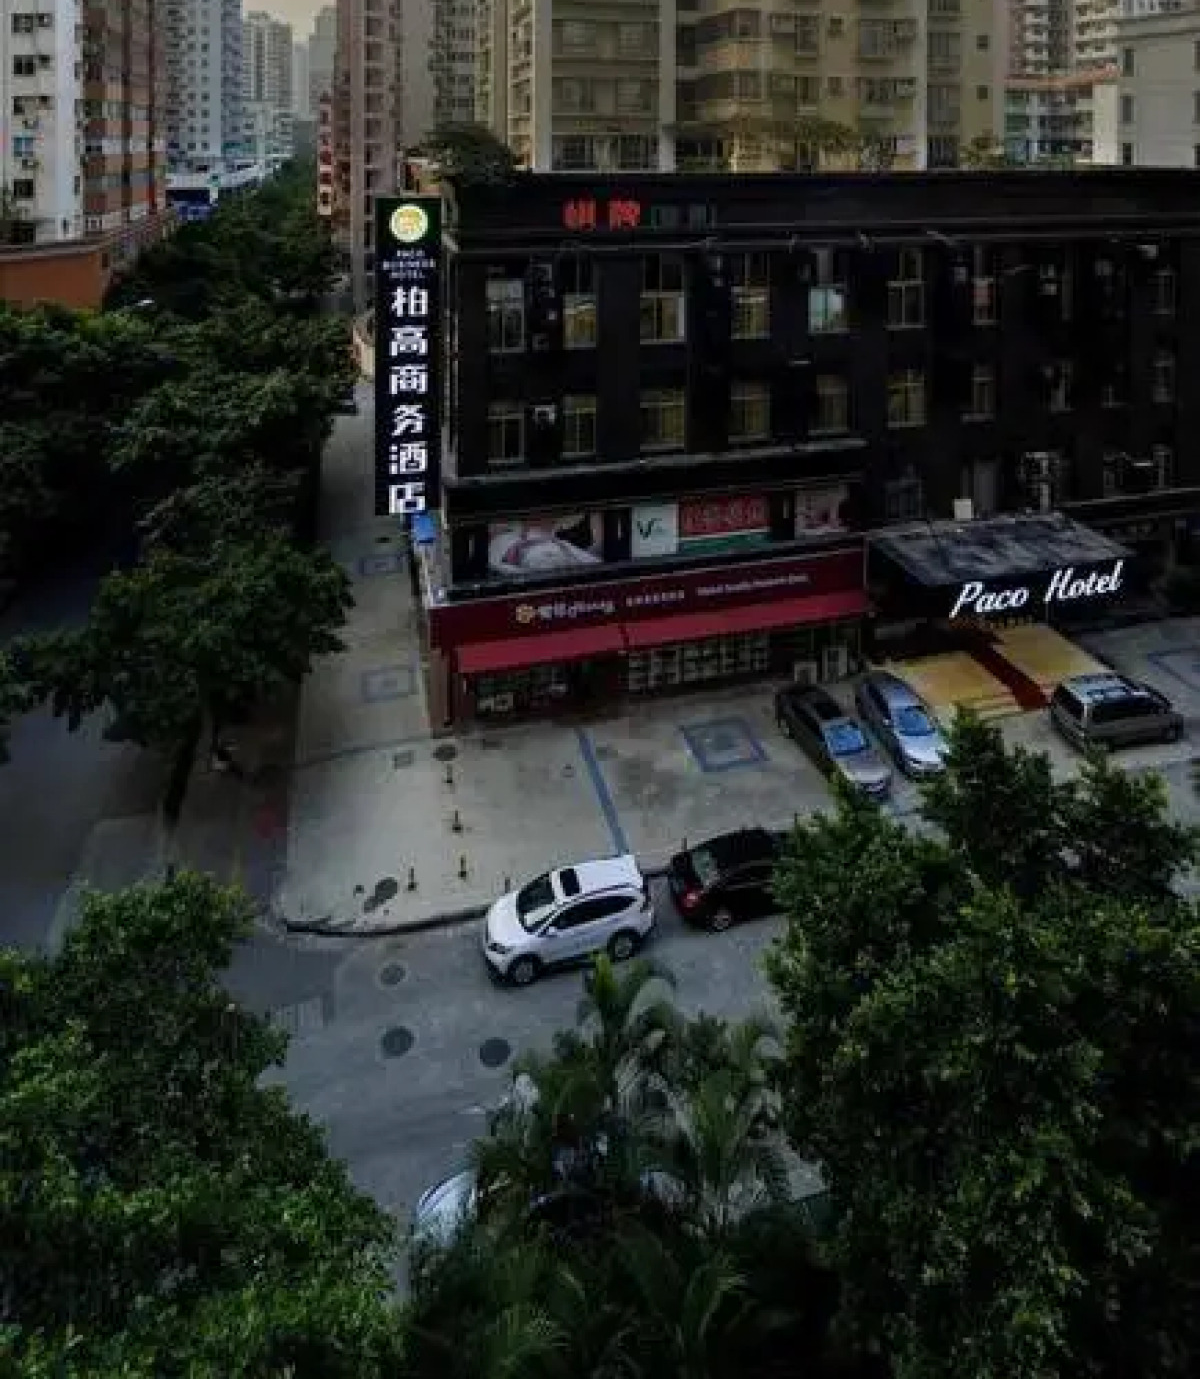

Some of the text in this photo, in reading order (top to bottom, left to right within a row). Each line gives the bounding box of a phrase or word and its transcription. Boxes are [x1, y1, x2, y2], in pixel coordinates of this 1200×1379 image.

[388, 286, 429, 514] 柏高商务酒店
[948, 559, 1125, 618] Paco Hotel
